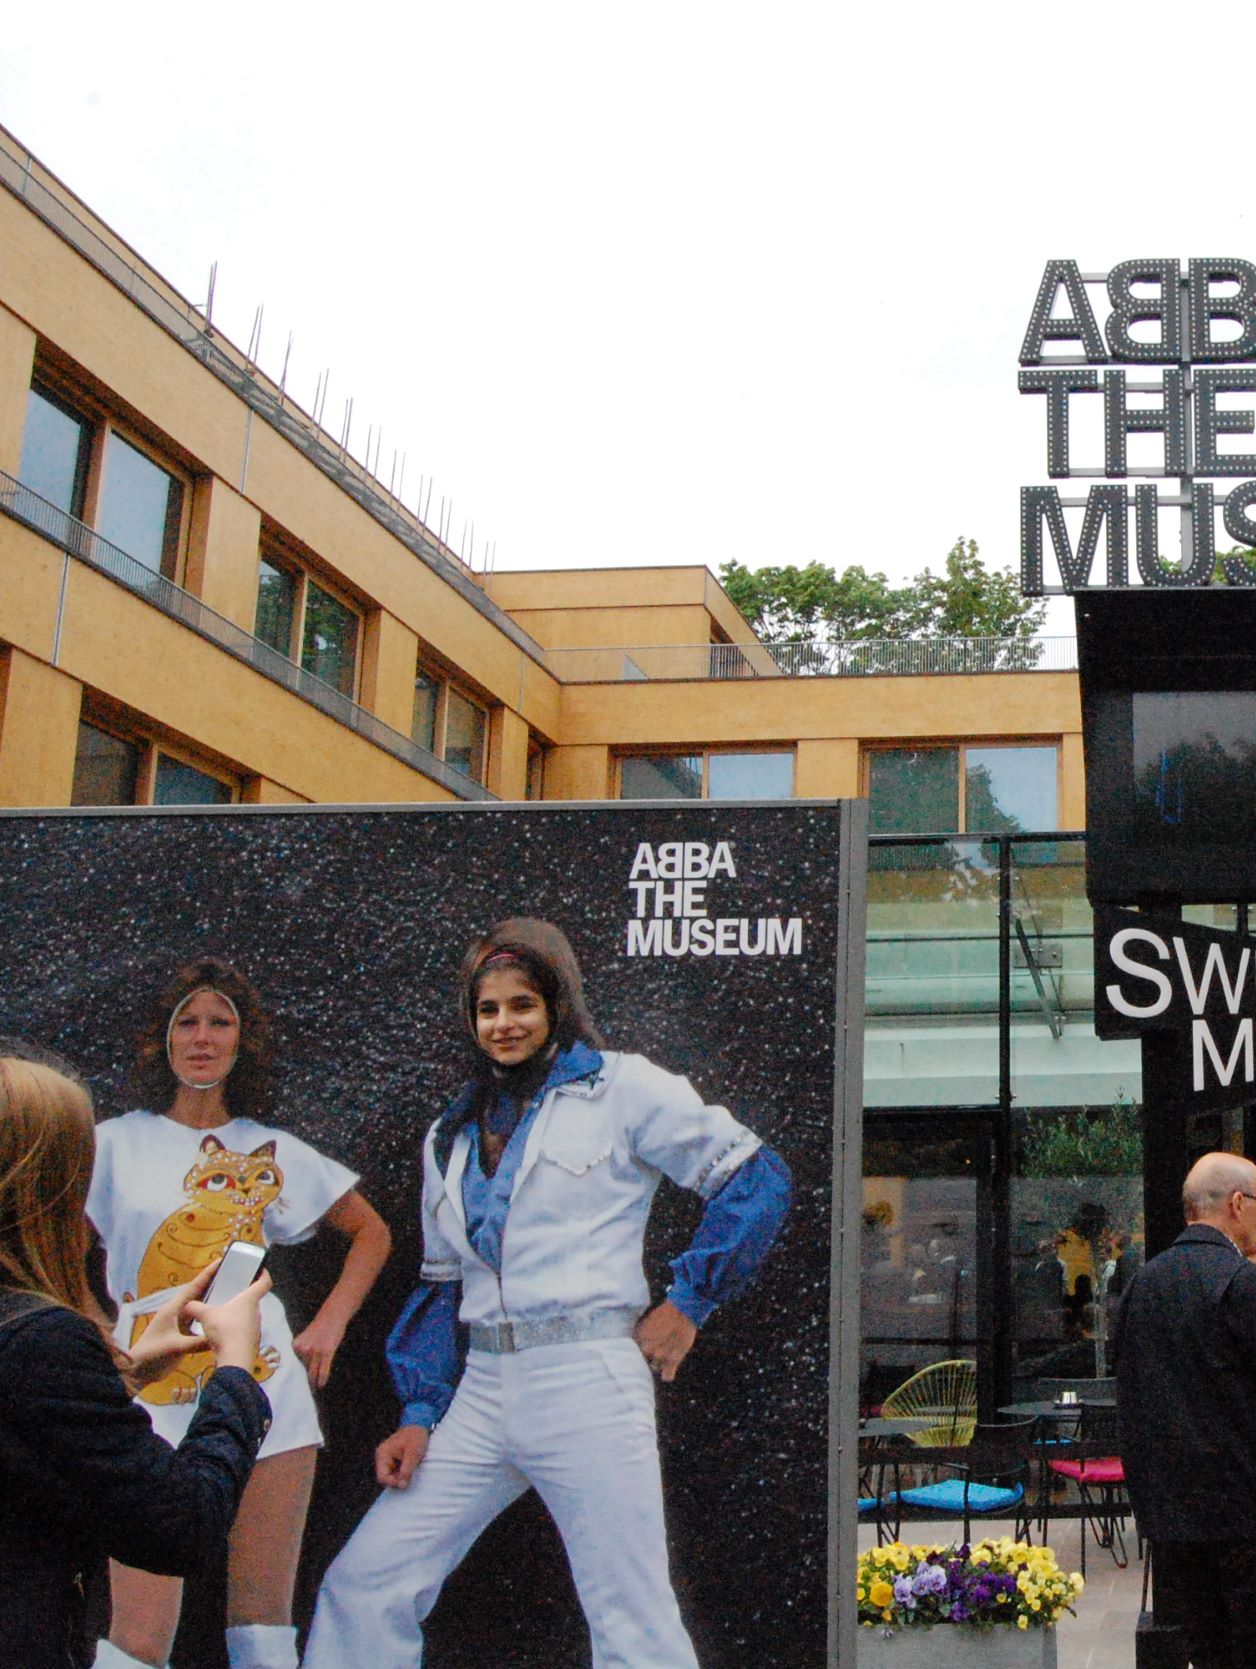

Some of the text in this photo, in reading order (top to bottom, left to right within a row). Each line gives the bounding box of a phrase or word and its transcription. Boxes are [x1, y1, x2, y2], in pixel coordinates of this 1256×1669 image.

[629, 841, 737, 879] ABBA
[628, 880, 708, 918] THE
[627, 918, 803, 957] MUSEUM
